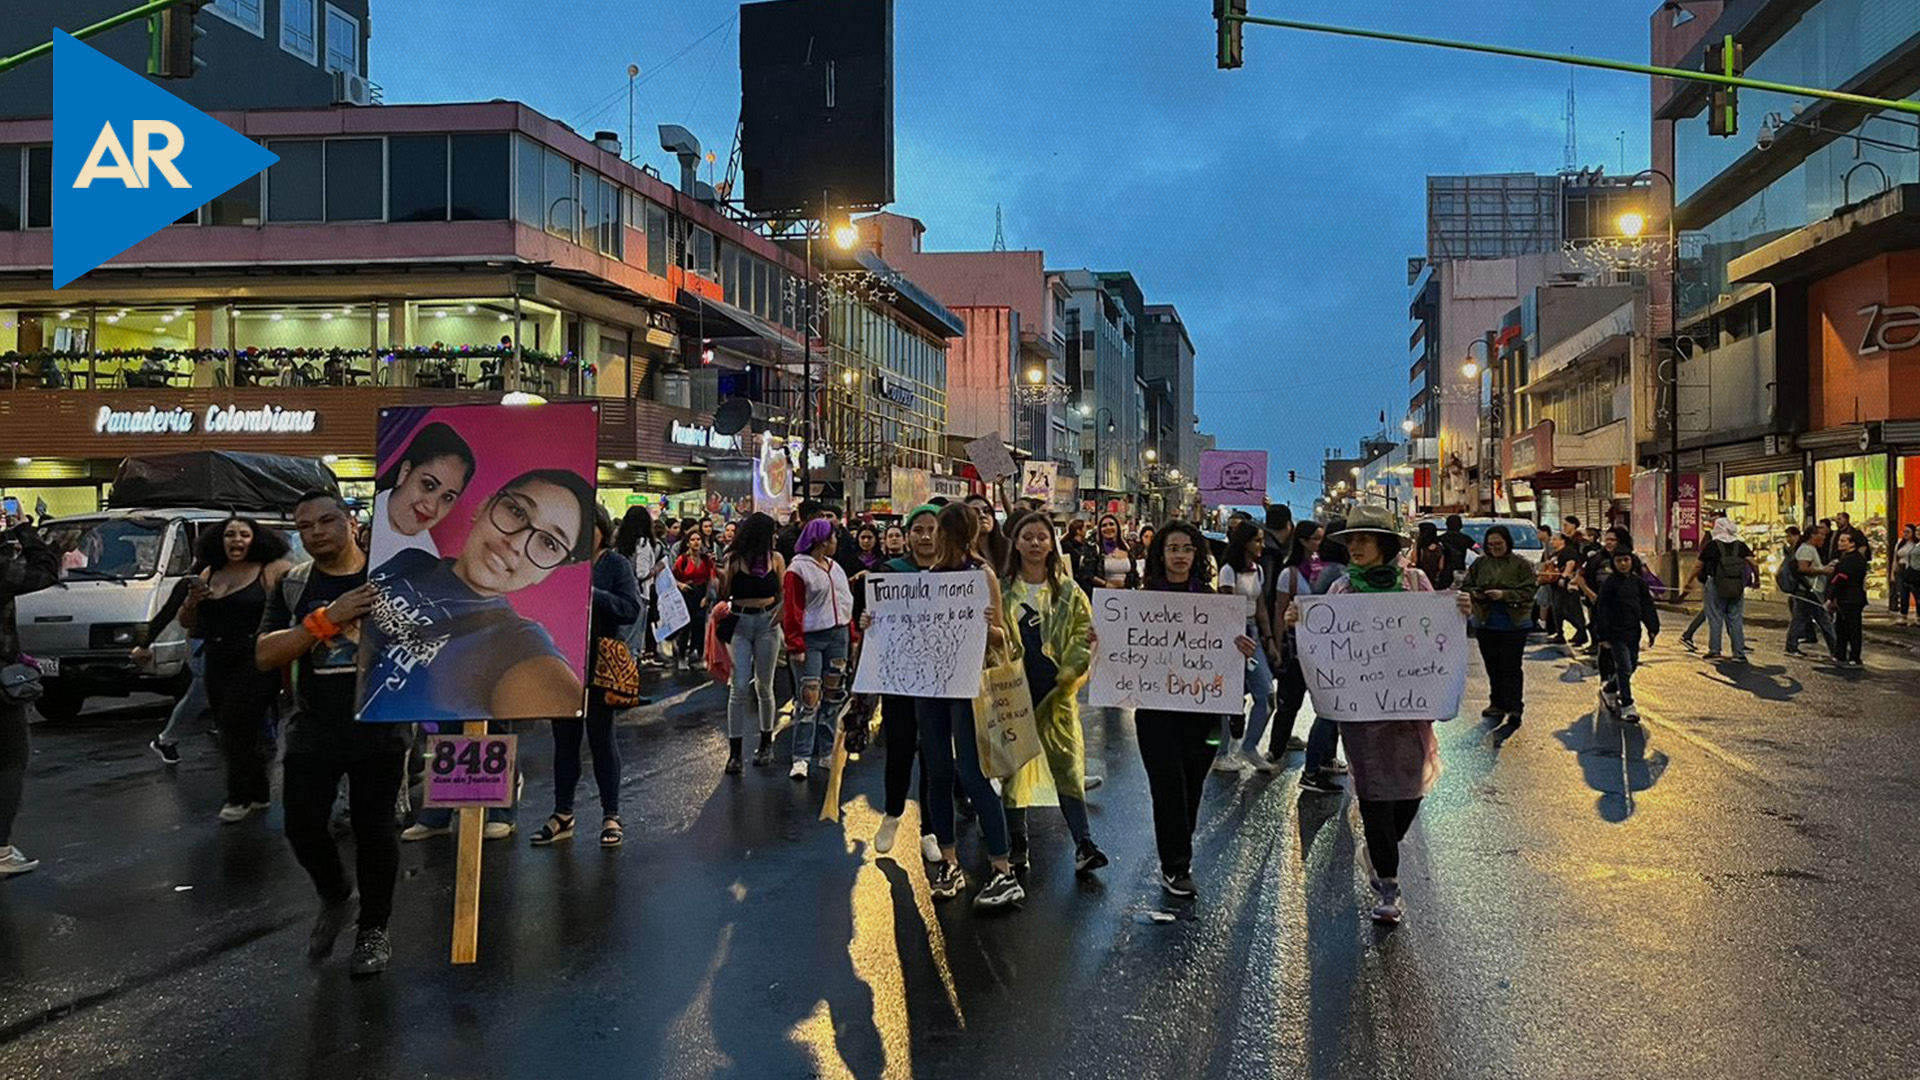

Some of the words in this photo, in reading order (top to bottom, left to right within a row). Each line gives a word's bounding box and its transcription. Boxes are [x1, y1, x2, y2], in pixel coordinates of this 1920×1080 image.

[96, 405, 193, 433] Panaderia
[204, 404, 316, 432] Colombiana
[868, 577, 931, 608] Tranquila,
[938, 579, 975, 599] mamá
[1104, 597, 1128, 622] Si
[1139, 604, 1183, 624] vuelve
[1194, 605, 1208, 624] la
[1305, 603, 1363, 634] Que
[1372, 614, 1406, 631] ser
[1127, 627, 1168, 648] Edad
[1173, 630, 1222, 649] Media
[1330, 637, 1388, 666] Mujer
[1109, 649, 1148, 669] estoy
[1182, 653, 1213, 670] lado
[1115, 675, 1134, 690] de
[1139, 675, 1160, 692] las
[1168, 673, 1222, 704] Brujas
[1316, 668, 1346, 690] No
[1360, 671, 1384, 682] nos
[1397, 661, 1449, 678] cueste
[1334, 696, 1357, 712] La
[1375, 689, 1429, 713] Vida
[432, 741, 507, 775] 848
